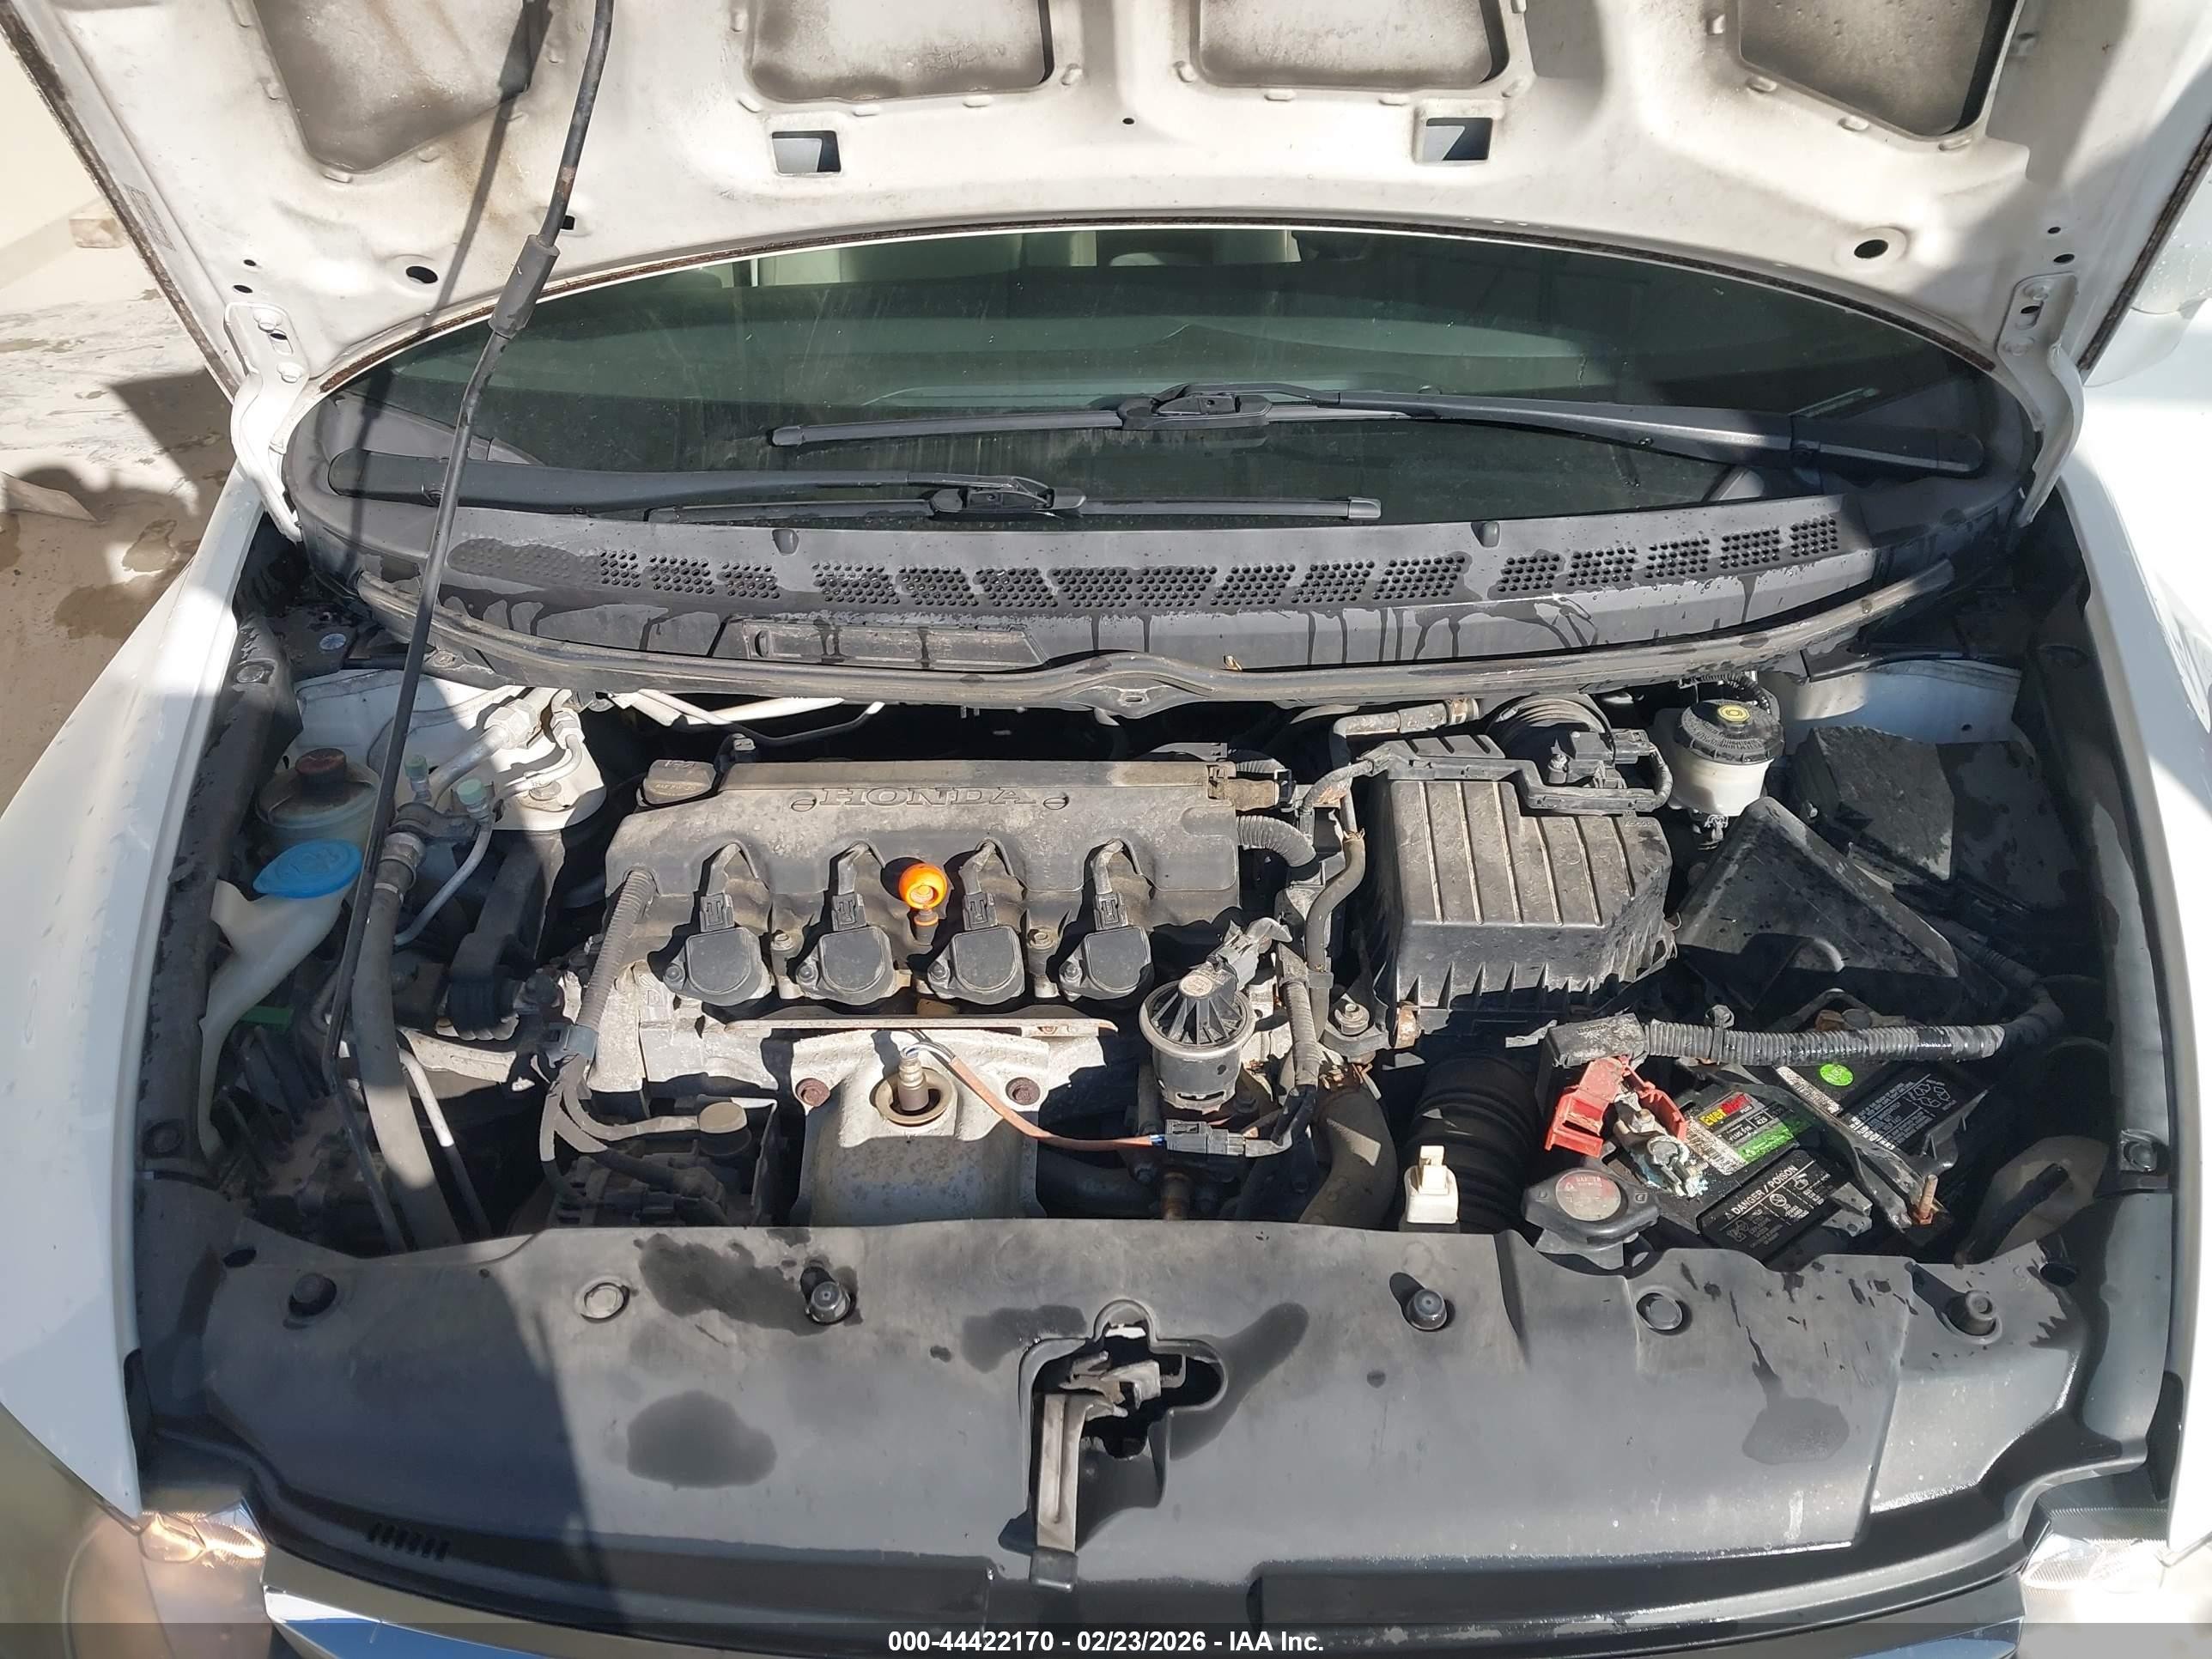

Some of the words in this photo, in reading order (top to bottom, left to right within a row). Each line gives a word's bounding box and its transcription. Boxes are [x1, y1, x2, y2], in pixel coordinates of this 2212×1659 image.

[818, 787, 1036, 807] HONDA
[1730, 1189, 1765, 1215] DANGER
[1767, 1164, 1799, 1188] POISON
